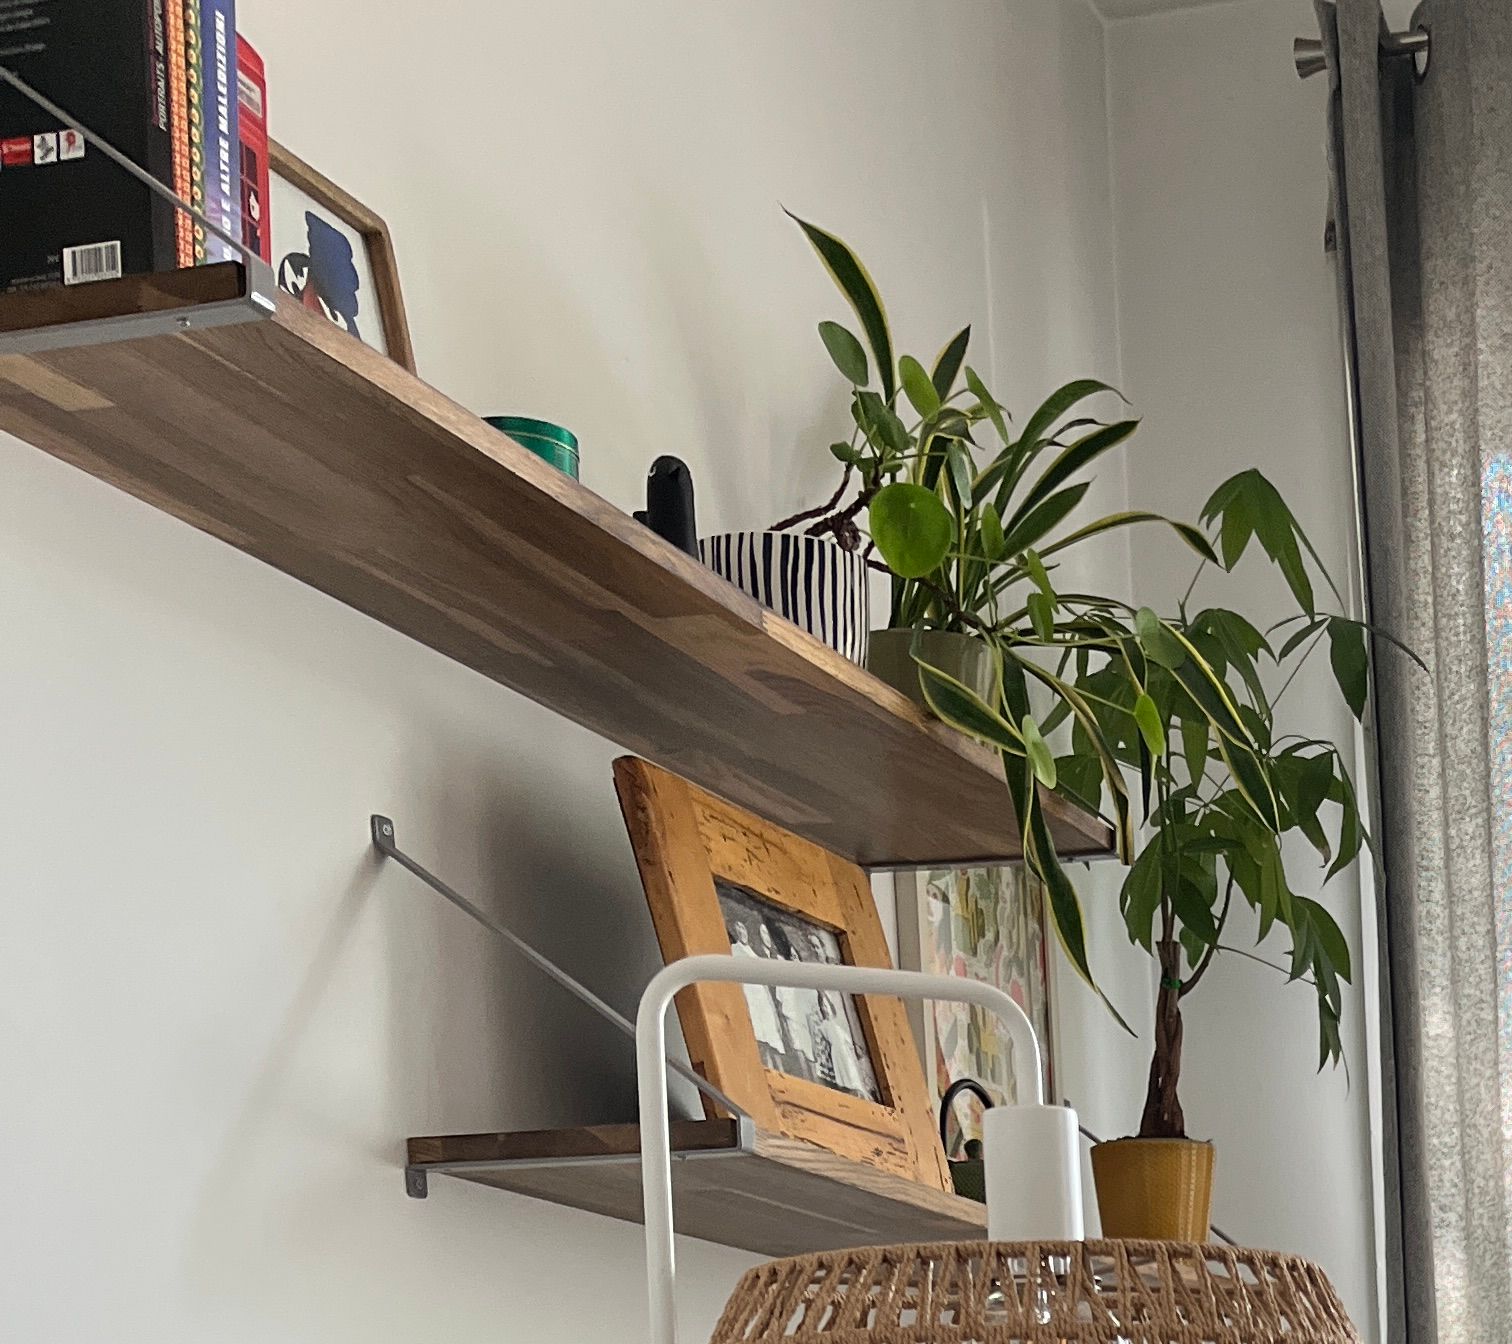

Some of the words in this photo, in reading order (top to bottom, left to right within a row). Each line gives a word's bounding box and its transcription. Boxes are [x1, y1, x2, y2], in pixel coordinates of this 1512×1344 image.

[156, 61, 167, 132] PORTRAITS
[215, 9, 230, 135] MALEDIZIONI
[219, 136, 231, 197] ALTRE
